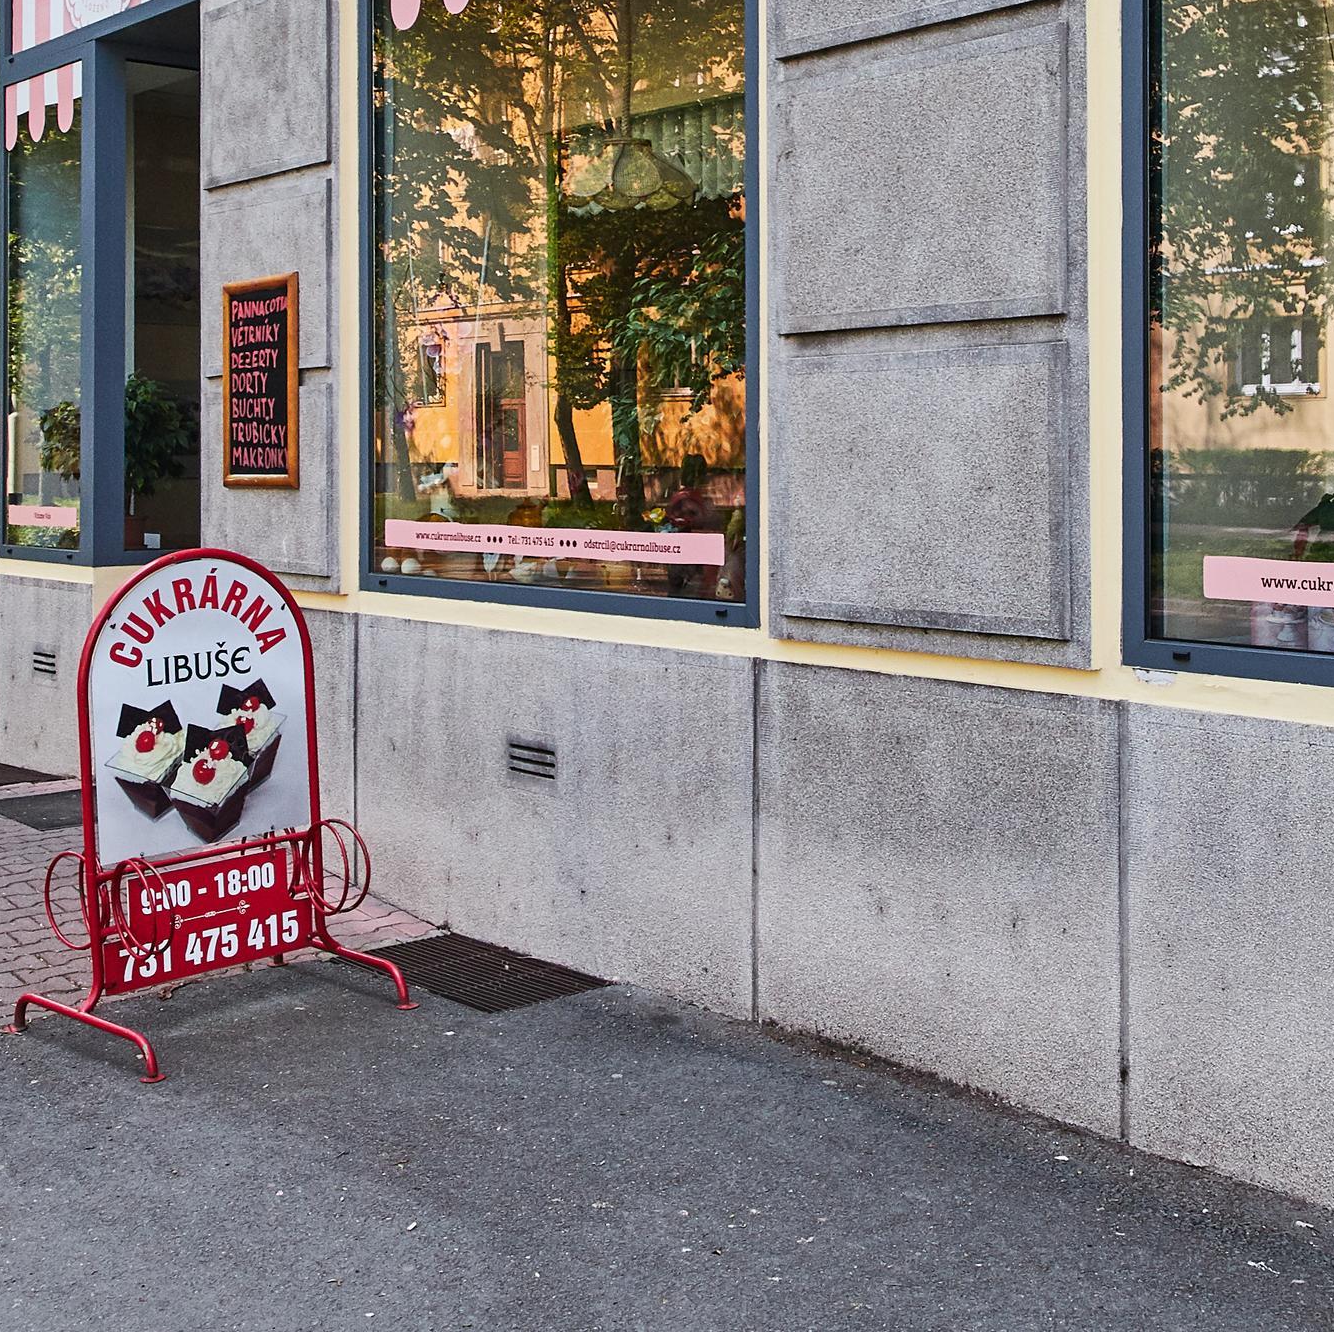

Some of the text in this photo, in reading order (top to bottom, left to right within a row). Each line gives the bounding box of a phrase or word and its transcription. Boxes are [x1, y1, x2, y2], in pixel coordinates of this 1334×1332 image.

[231, 348, 279, 369] DEZERTY
[232, 370, 268, 395] DORTY
[232, 397, 276, 420] BUCHTY
[415, 531, 482, 543] www.cukrarnalibuse.cz
[521, 536, 532, 546] 731
[532, 536, 543, 546] 475
[544, 537, 555, 547] 415
[583, 539, 681, 554] odstrcil@cukrarnalibuse.cz
[109, 567, 287, 668] CUKRÁRNA
[146, 641, 252, 687] LIBUŠE
[140, 880, 192, 915] 9:00
[213, 861, 275, 899] 18:00
[119, 909, 299, 983] 731 475 415
